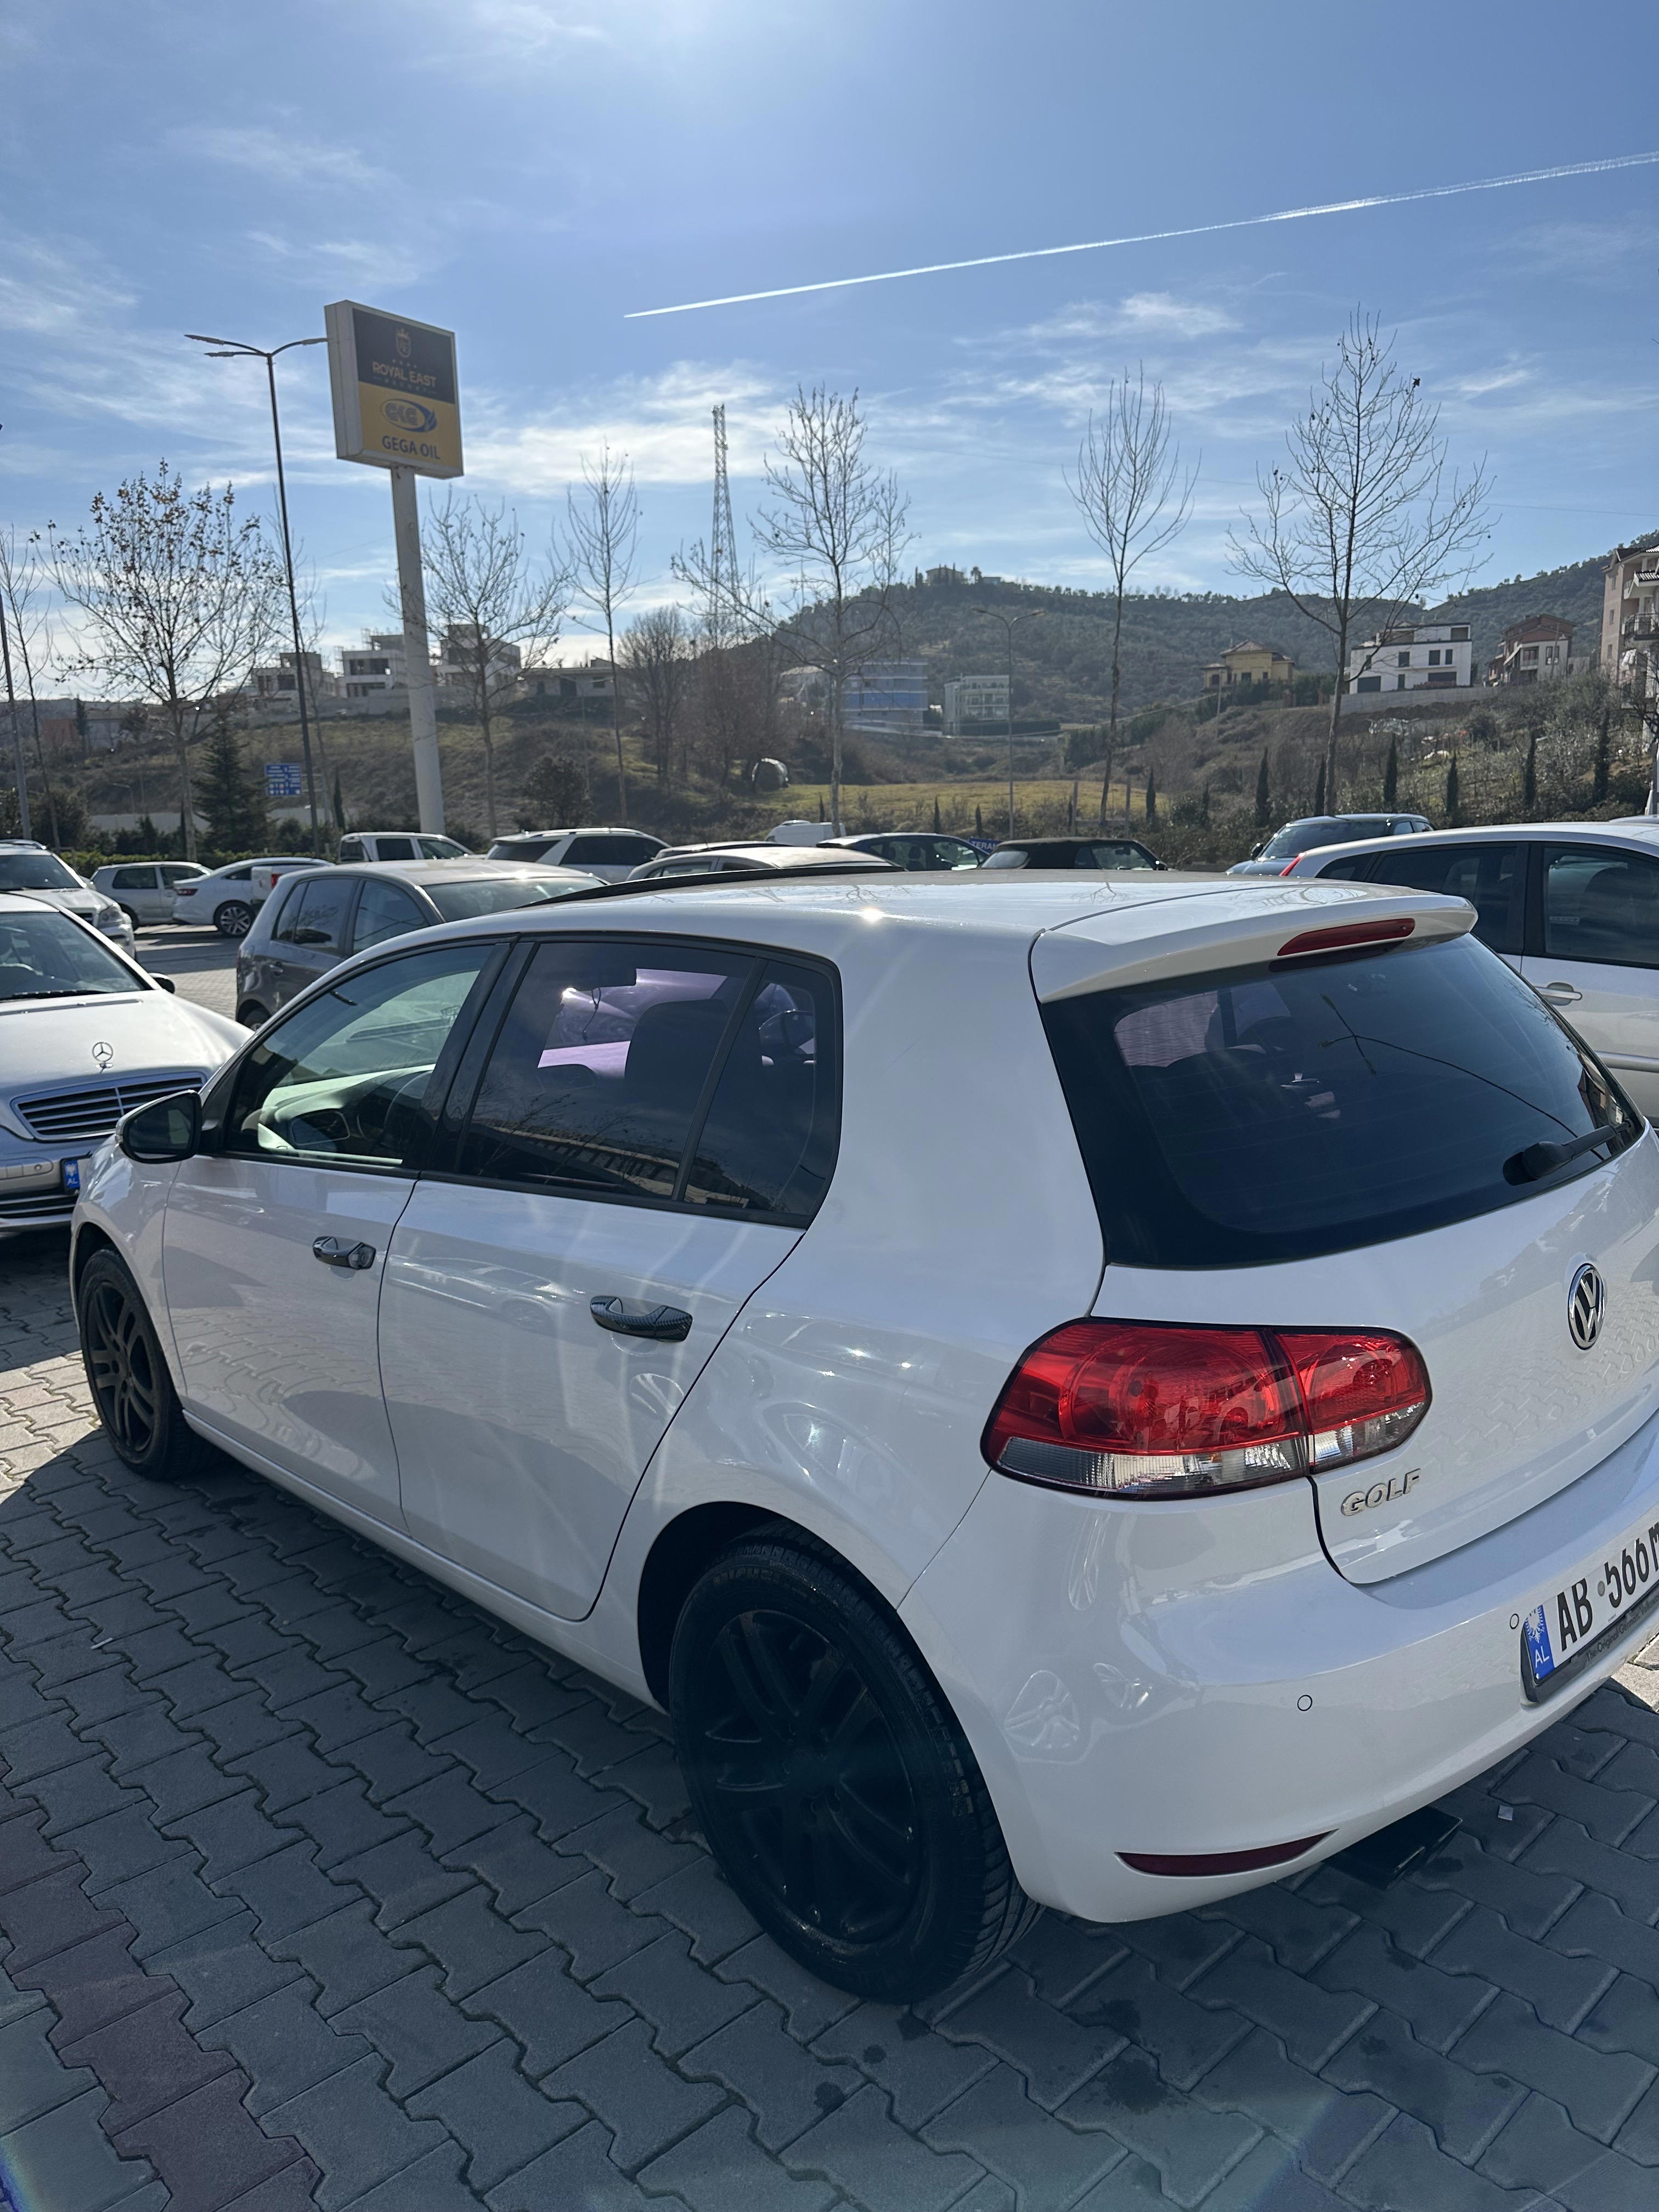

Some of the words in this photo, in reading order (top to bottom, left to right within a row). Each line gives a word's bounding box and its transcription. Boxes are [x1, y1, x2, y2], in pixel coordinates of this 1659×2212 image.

[373, 362, 407, 381] ROYAL
[409, 371, 437, 387] EAST
[382, 435, 417, 455] GEGA
[420, 443, 440, 460] OIL
[1341, 1468, 1421, 1516] GOLF
[1557, 1578, 1593, 1652] AB
[1535, 1645, 1550, 1668] AL
